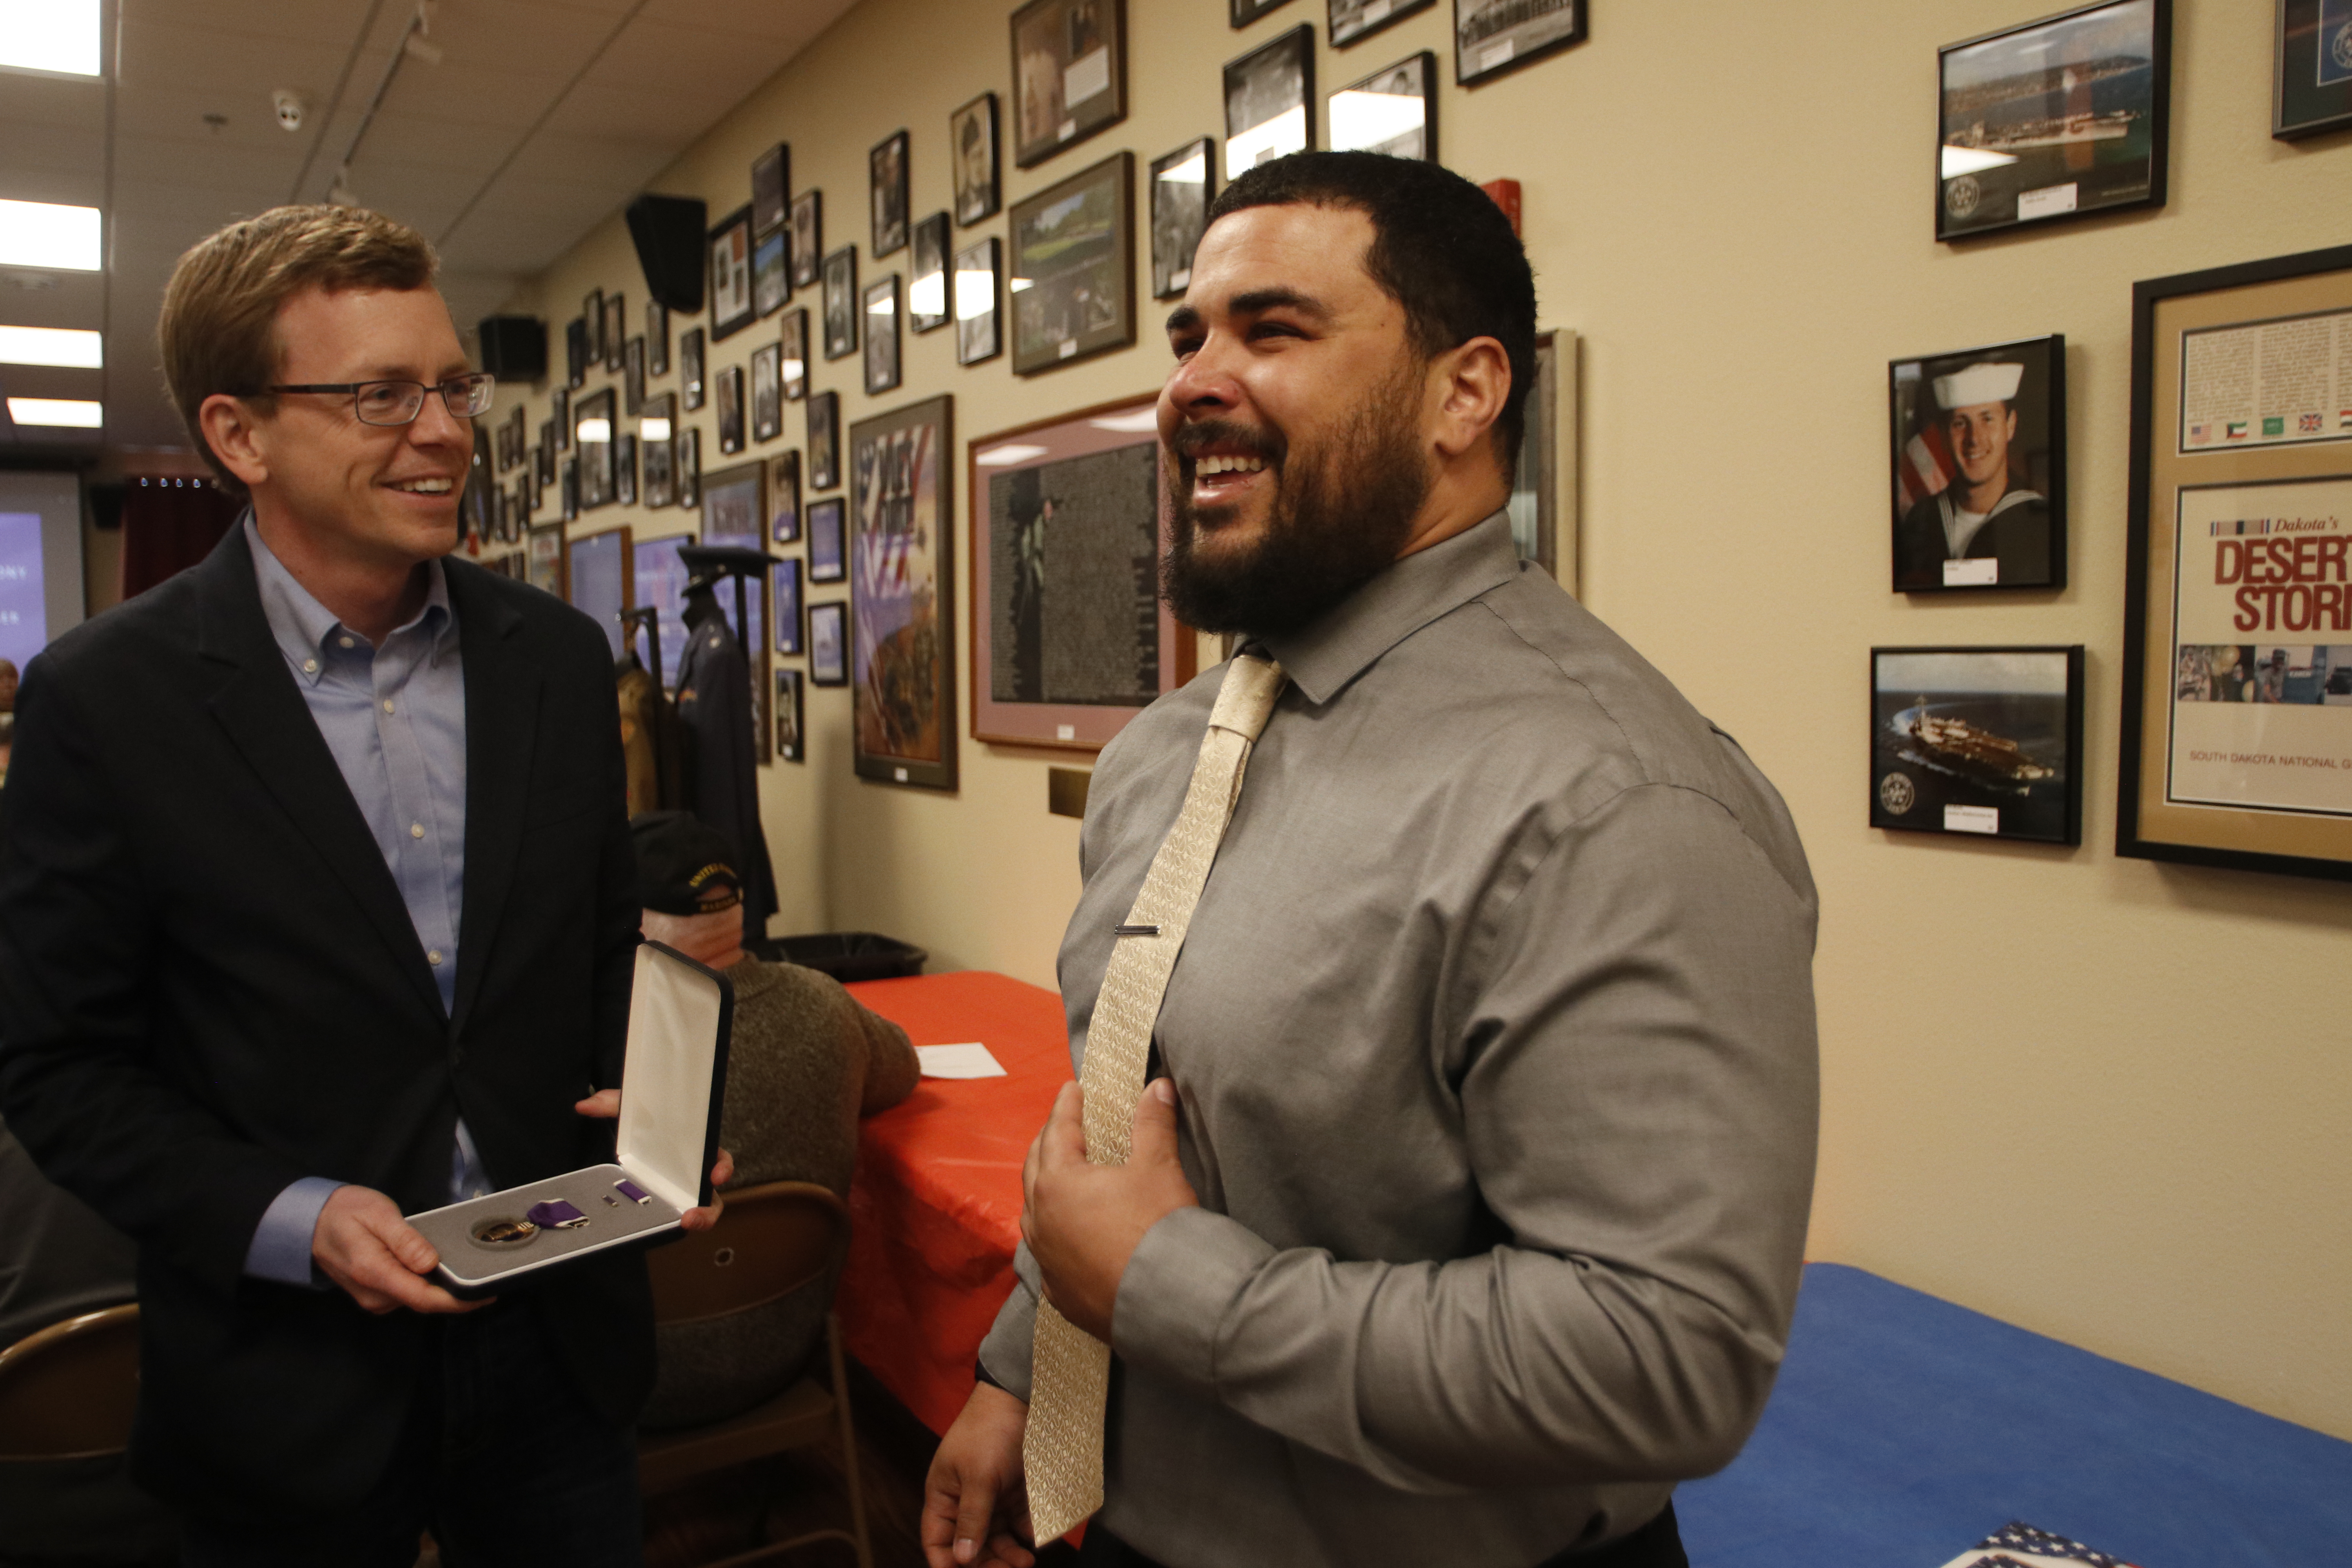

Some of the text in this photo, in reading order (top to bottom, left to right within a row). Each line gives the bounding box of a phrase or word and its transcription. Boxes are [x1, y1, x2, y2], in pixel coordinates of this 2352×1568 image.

[2275, 515, 2339, 532] Dakota's
[2189, 750, 2227, 762] SOUTH
[2230, 752, 2276, 765] DAKOTA
[2279, 755, 2337, 769] NATIONAL
